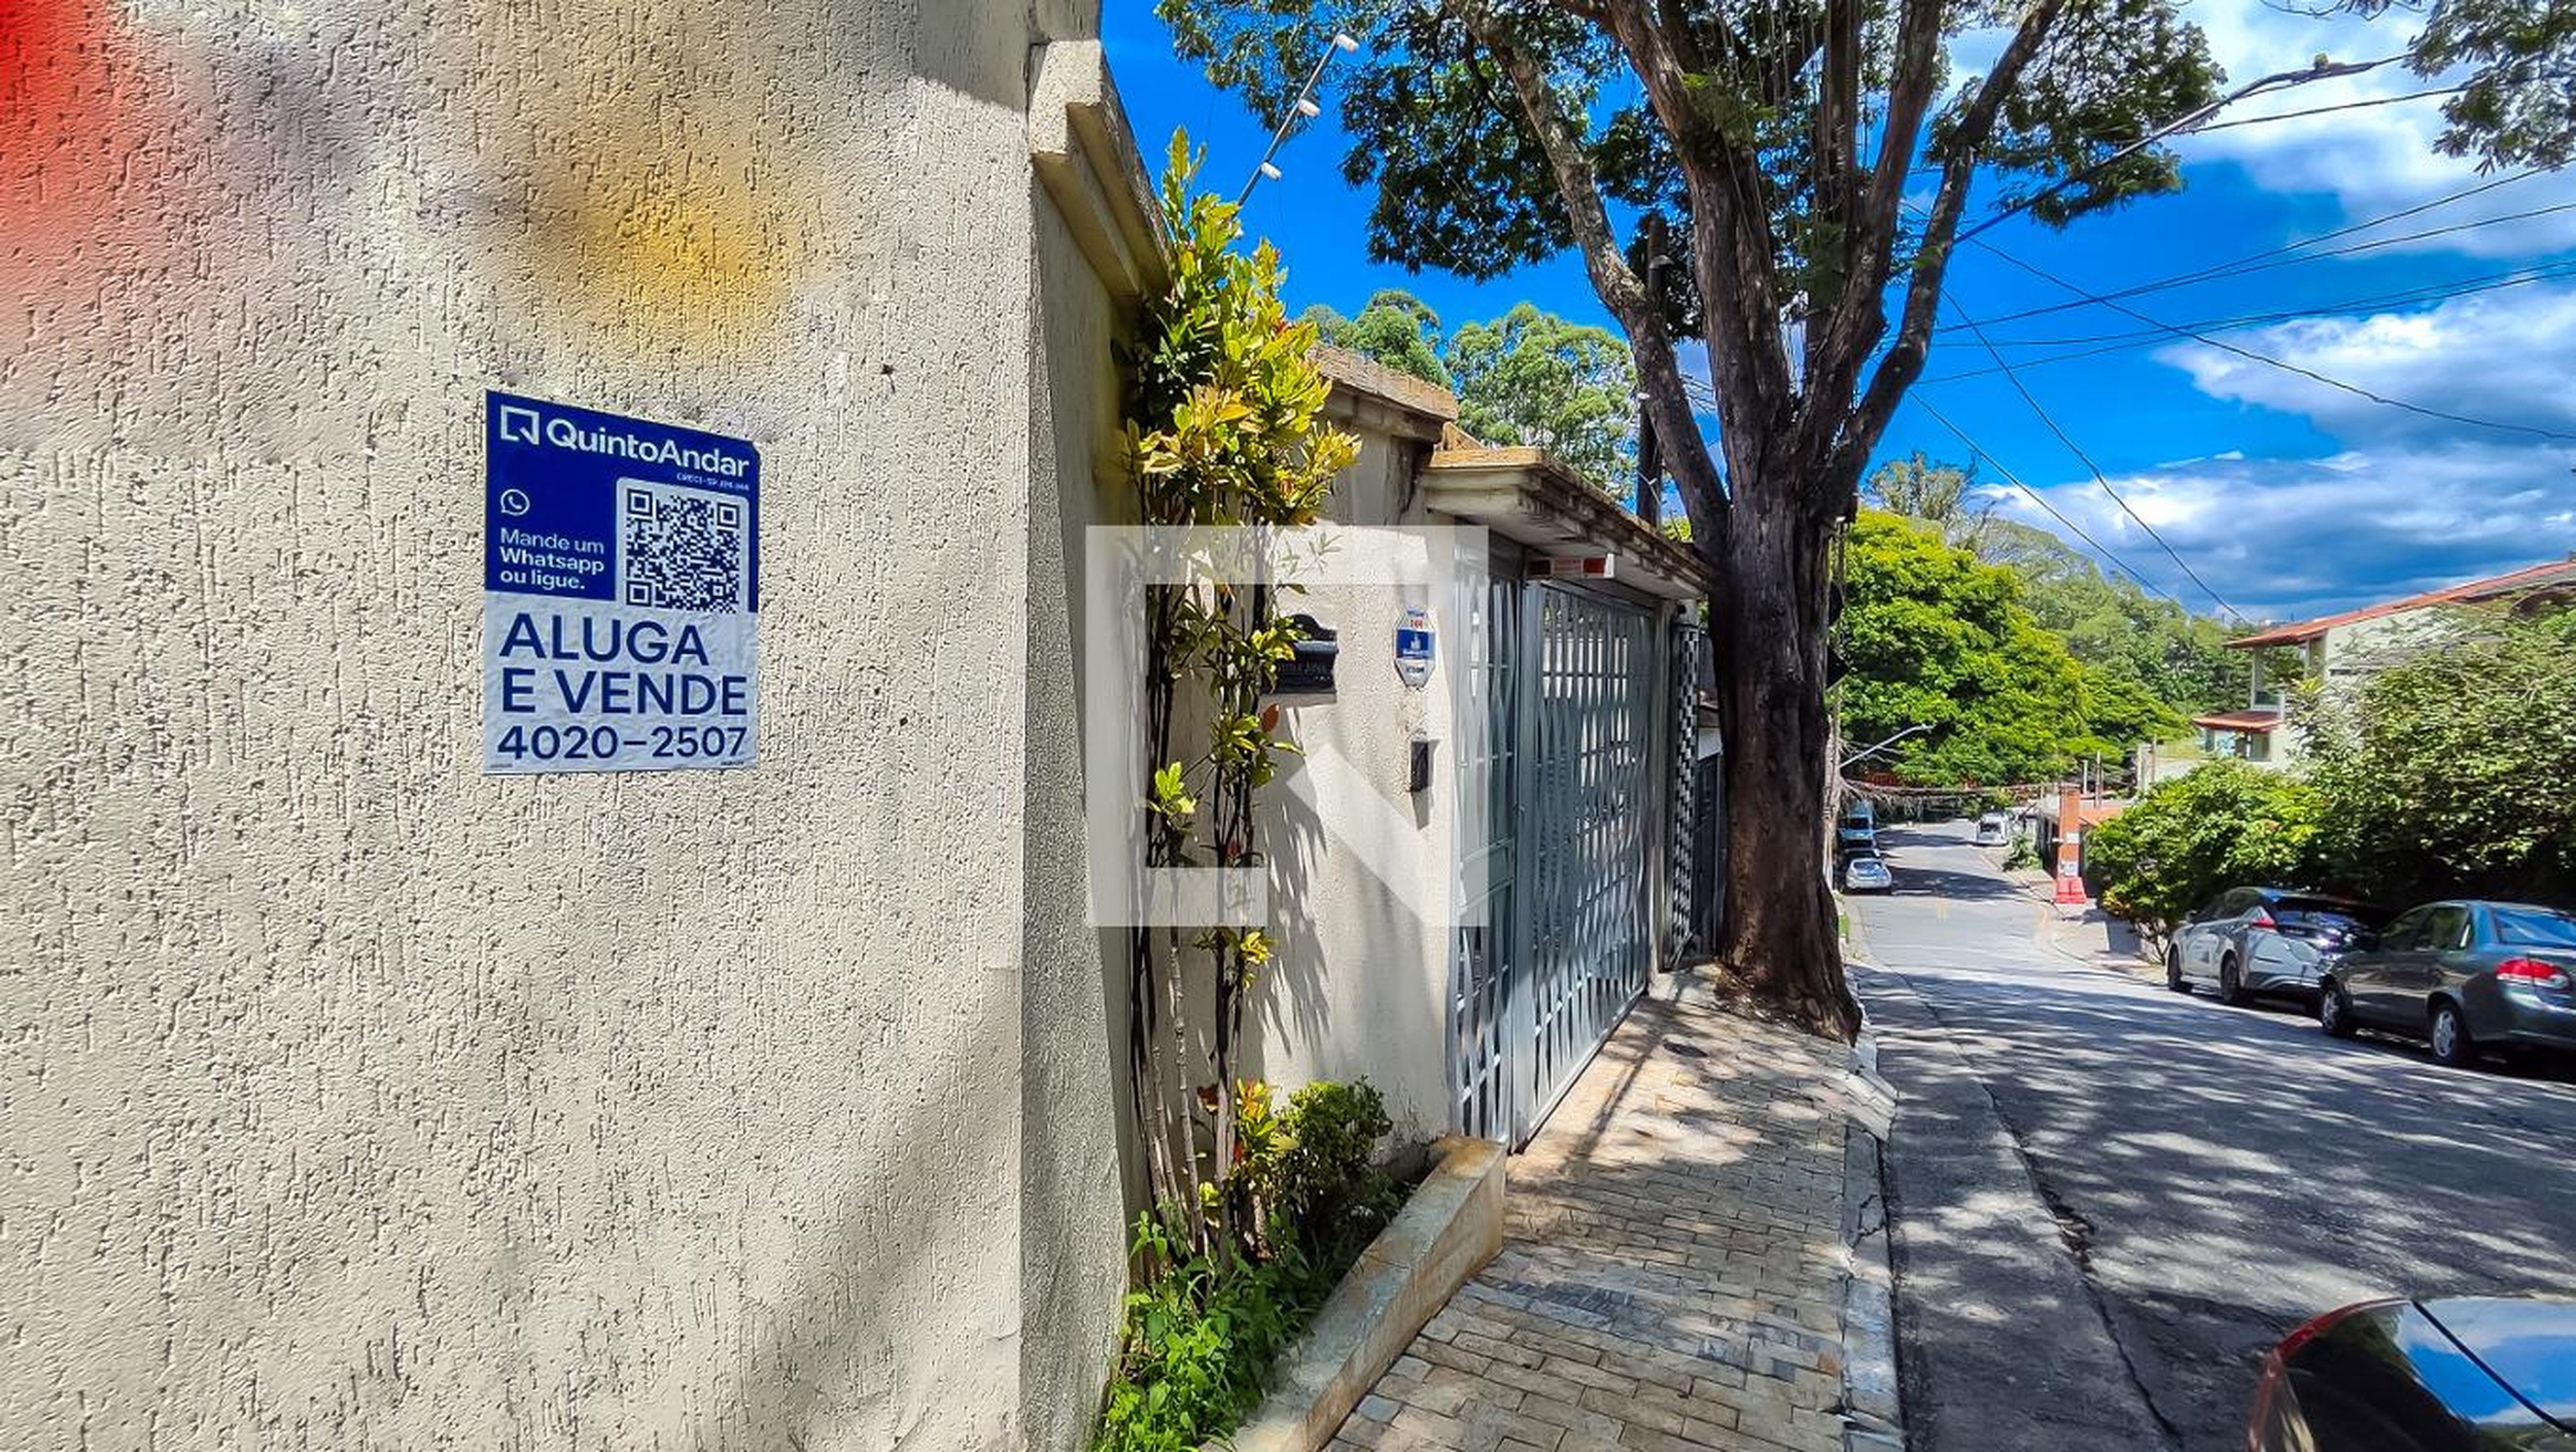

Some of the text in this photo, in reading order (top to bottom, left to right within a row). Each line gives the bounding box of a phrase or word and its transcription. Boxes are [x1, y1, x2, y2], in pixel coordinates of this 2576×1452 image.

[546, 418, 749, 478] QuintoAndar
[500, 527, 604, 555] Mande um
[499, 545, 604, 576] Whatsapp
[500, 569, 585, 591] ou ligue.
[498, 613, 709, 666] ALUGA
[502, 667, 747, 716] E VENDE
[497, 725, 747, 760] 4020-2507
